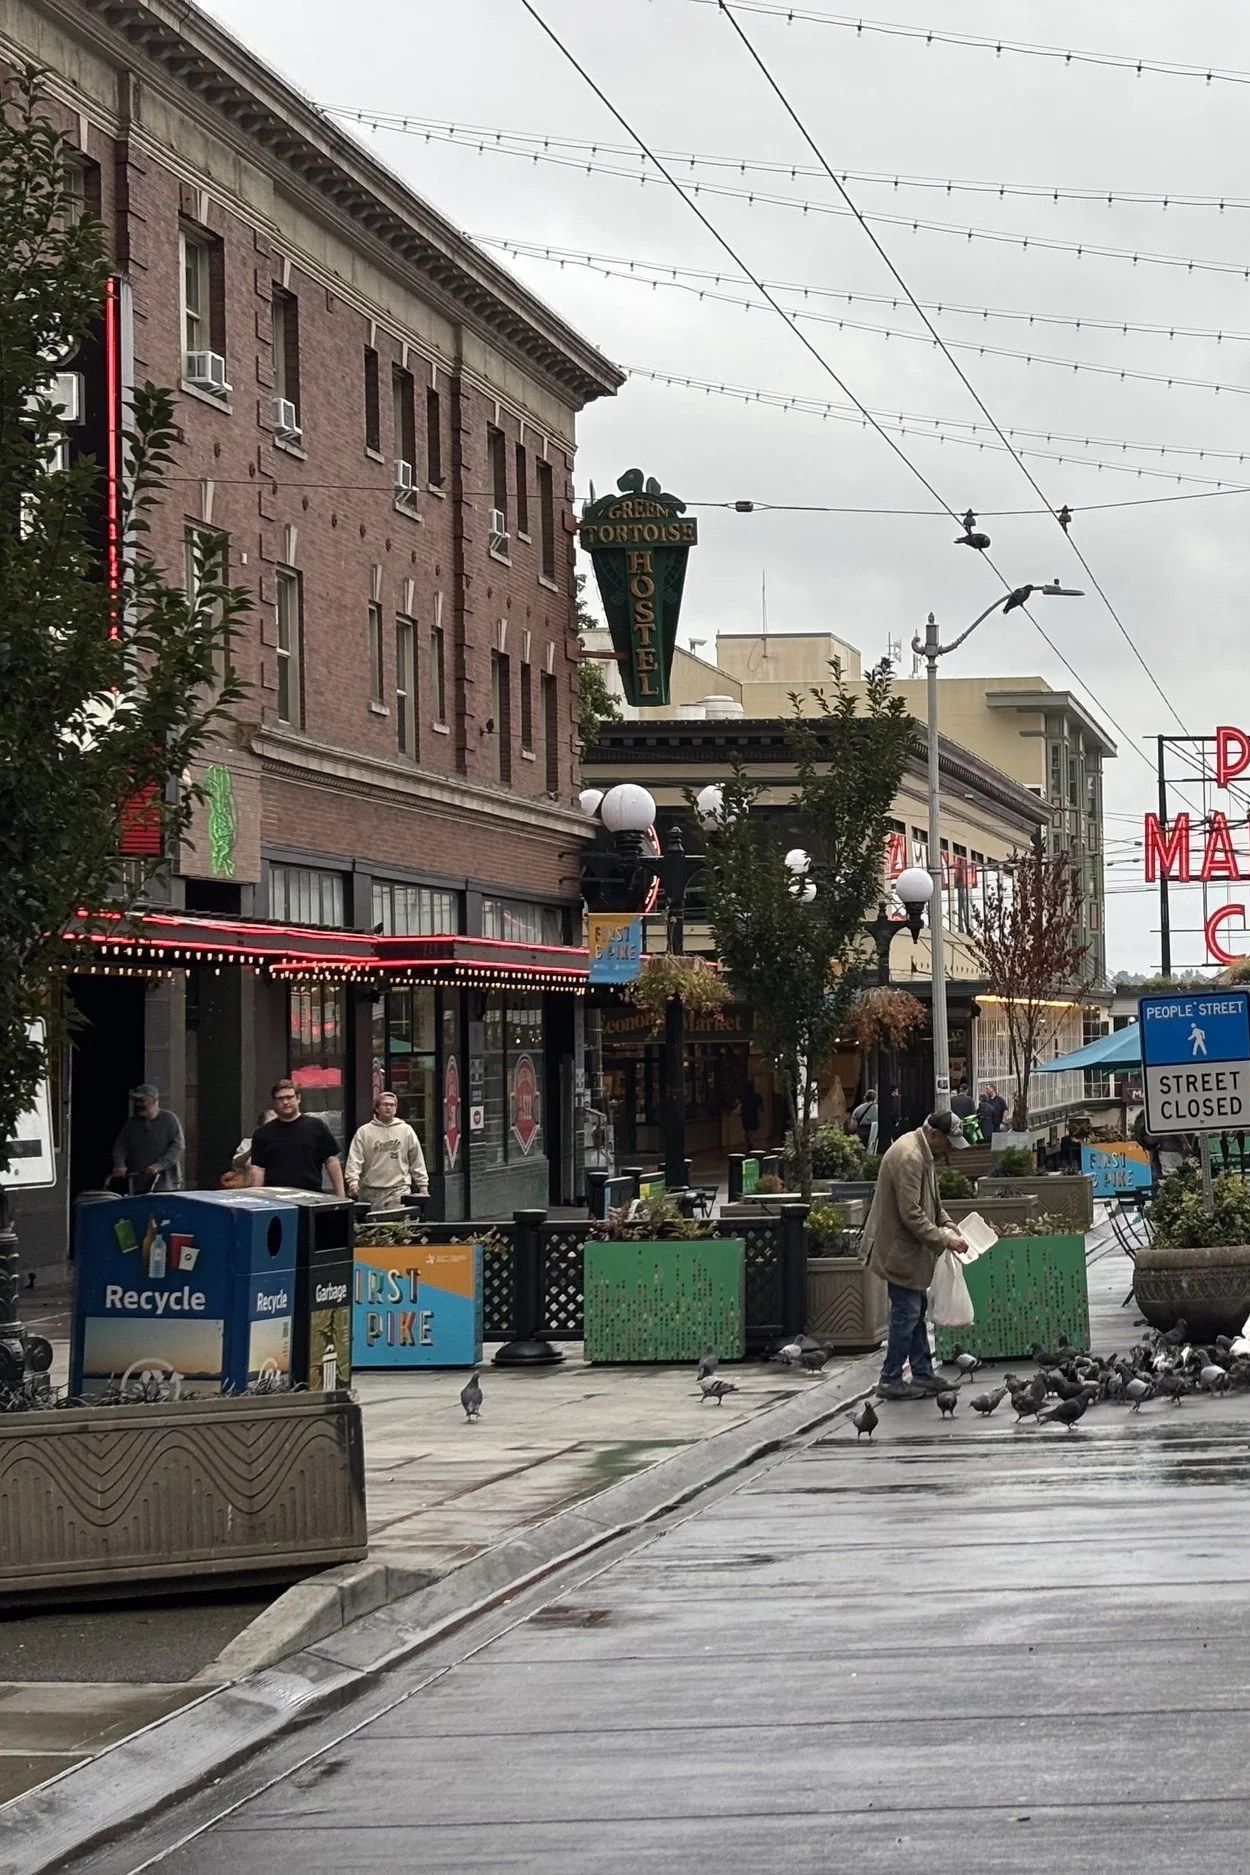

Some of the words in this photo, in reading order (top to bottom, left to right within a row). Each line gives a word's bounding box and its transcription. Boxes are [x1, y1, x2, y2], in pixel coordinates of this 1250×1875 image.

[608, 499, 669, 520] GREEN
[584, 523, 695, 544] TORTOISE
[627, 551, 659, 695] HOSTEL
[1146, 1004, 1193, 1019] PEOPLE
[1199, 1001, 1243, 1015] STREET
[1160, 1071, 1240, 1094] STREET
[1160, 1096, 1242, 1120] CLOSED
[1089, 1152, 1126, 1170] FIRST
[1103, 1170, 1134, 1188] PIKE
[315, 1282, 347, 1303] Garbage
[355, 1267, 421, 1305] IRST
[106, 1285, 206, 1314] Recycle
[256, 1288, 288, 1313] Recycle
[366, 1310, 435, 1347] PIKE
